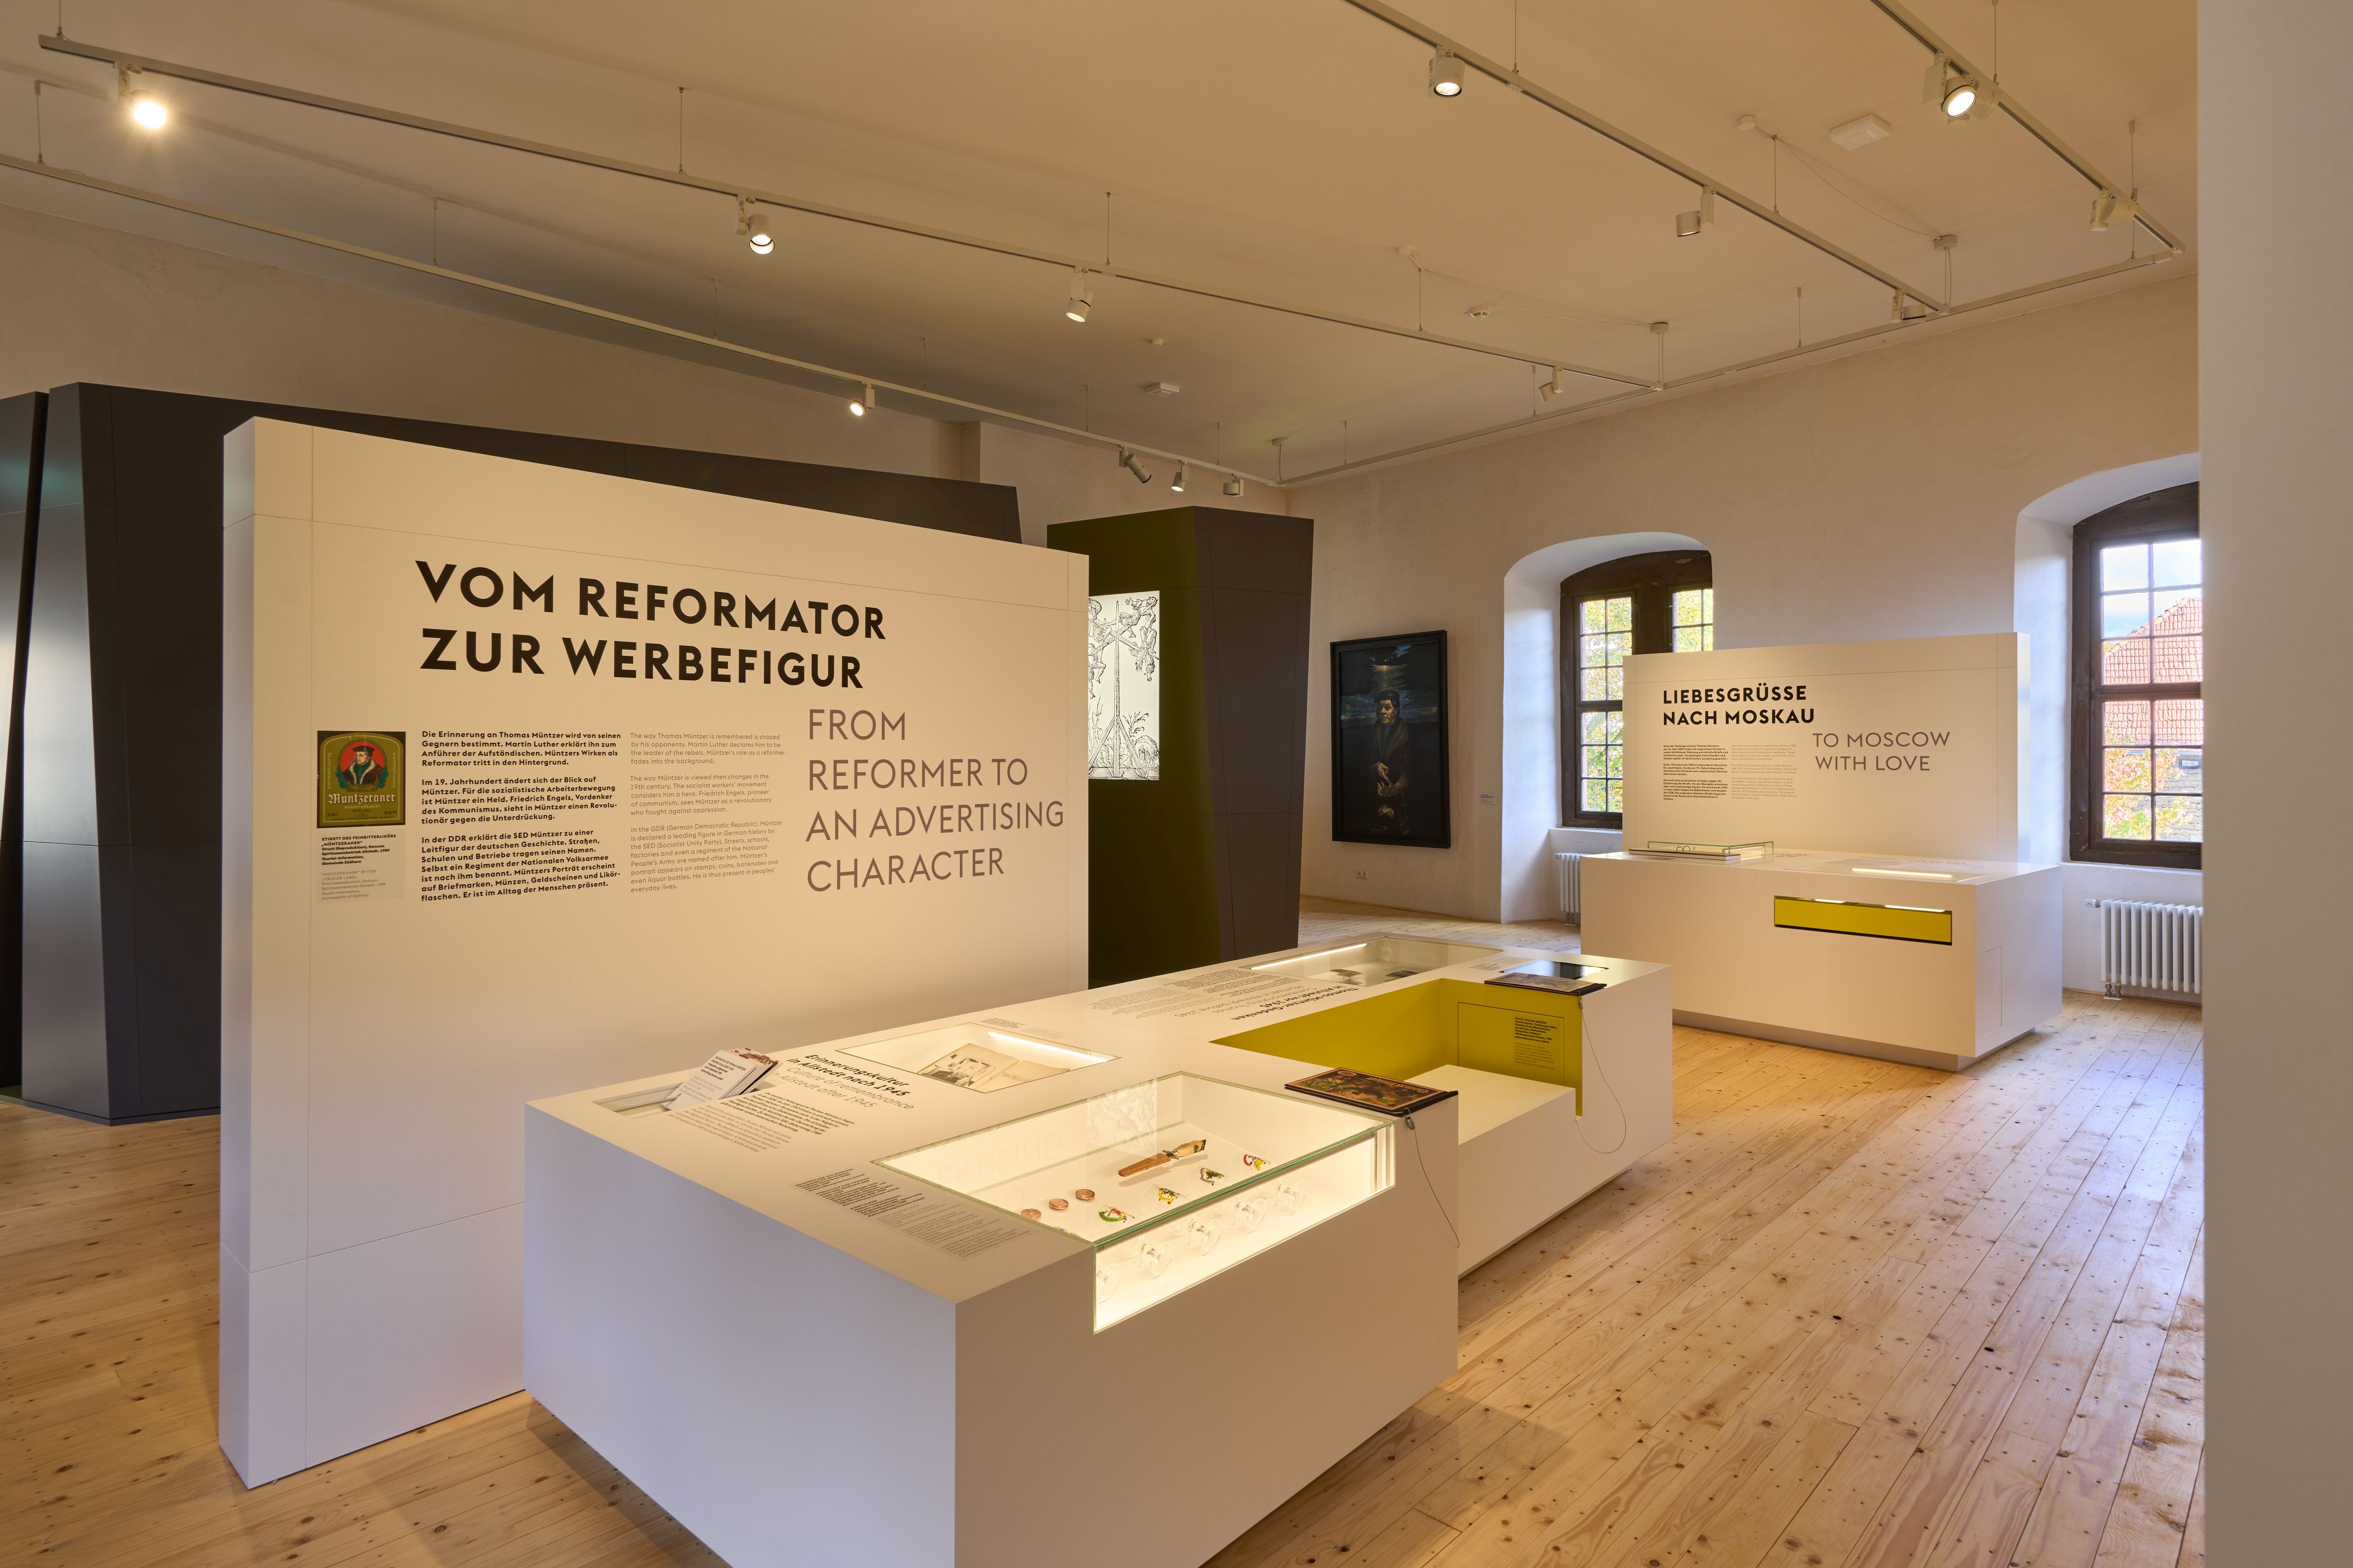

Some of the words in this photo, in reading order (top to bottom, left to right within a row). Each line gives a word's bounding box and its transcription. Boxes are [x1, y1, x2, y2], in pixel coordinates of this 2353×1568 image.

[415, 560, 553, 612] VOM
[579, 578, 886, 639] REFORMATOR
[420, 628, 544, 675] ZUR
[562, 637, 863, 688] WERBEFIGUR
[1663, 683, 1806, 704] LIEBESGRÜSSE
[809, 709, 905, 740] FROM
[1663, 711, 1717, 725] NACH
[1725, 708, 1814, 724] MOSKAU
[439, 731, 485, 739] Erinnerung
[1813, 733, 1838, 747] TO
[1847, 731, 1950, 747] MOSCOW
[809, 759, 983, 791] REFORMER
[991, 759, 1027, 785] TO
[1815, 756, 1866, 771] WITH
[1876, 756, 1930, 771] LOVE
[328, 793, 396, 804] Müntzeraner
[806, 809, 856, 842] AN
[868, 801, 1063, 838] ADVERTISING
[807, 848, 1005, 892] CHARACTER
[1231, 988, 1359, 1021] Thomas-Müntzer-Gedenken
[1299, 987, 1334, 998] Allstedt
[798, 1062, 845, 1077] Allstedt
[843, 1076, 875, 1086] nach
[873, 1085, 911, 1096] 1945
[805, 1054, 910, 1086] Erinnerungskultur
[777, 1075, 820, 1089] Allstedt
[817, 1088, 847, 1098] after
[843, 1097, 879, 1107] 1945
[787, 1067, 825, 1081] Culture
[834, 1083, 914, 1109] remembrance
